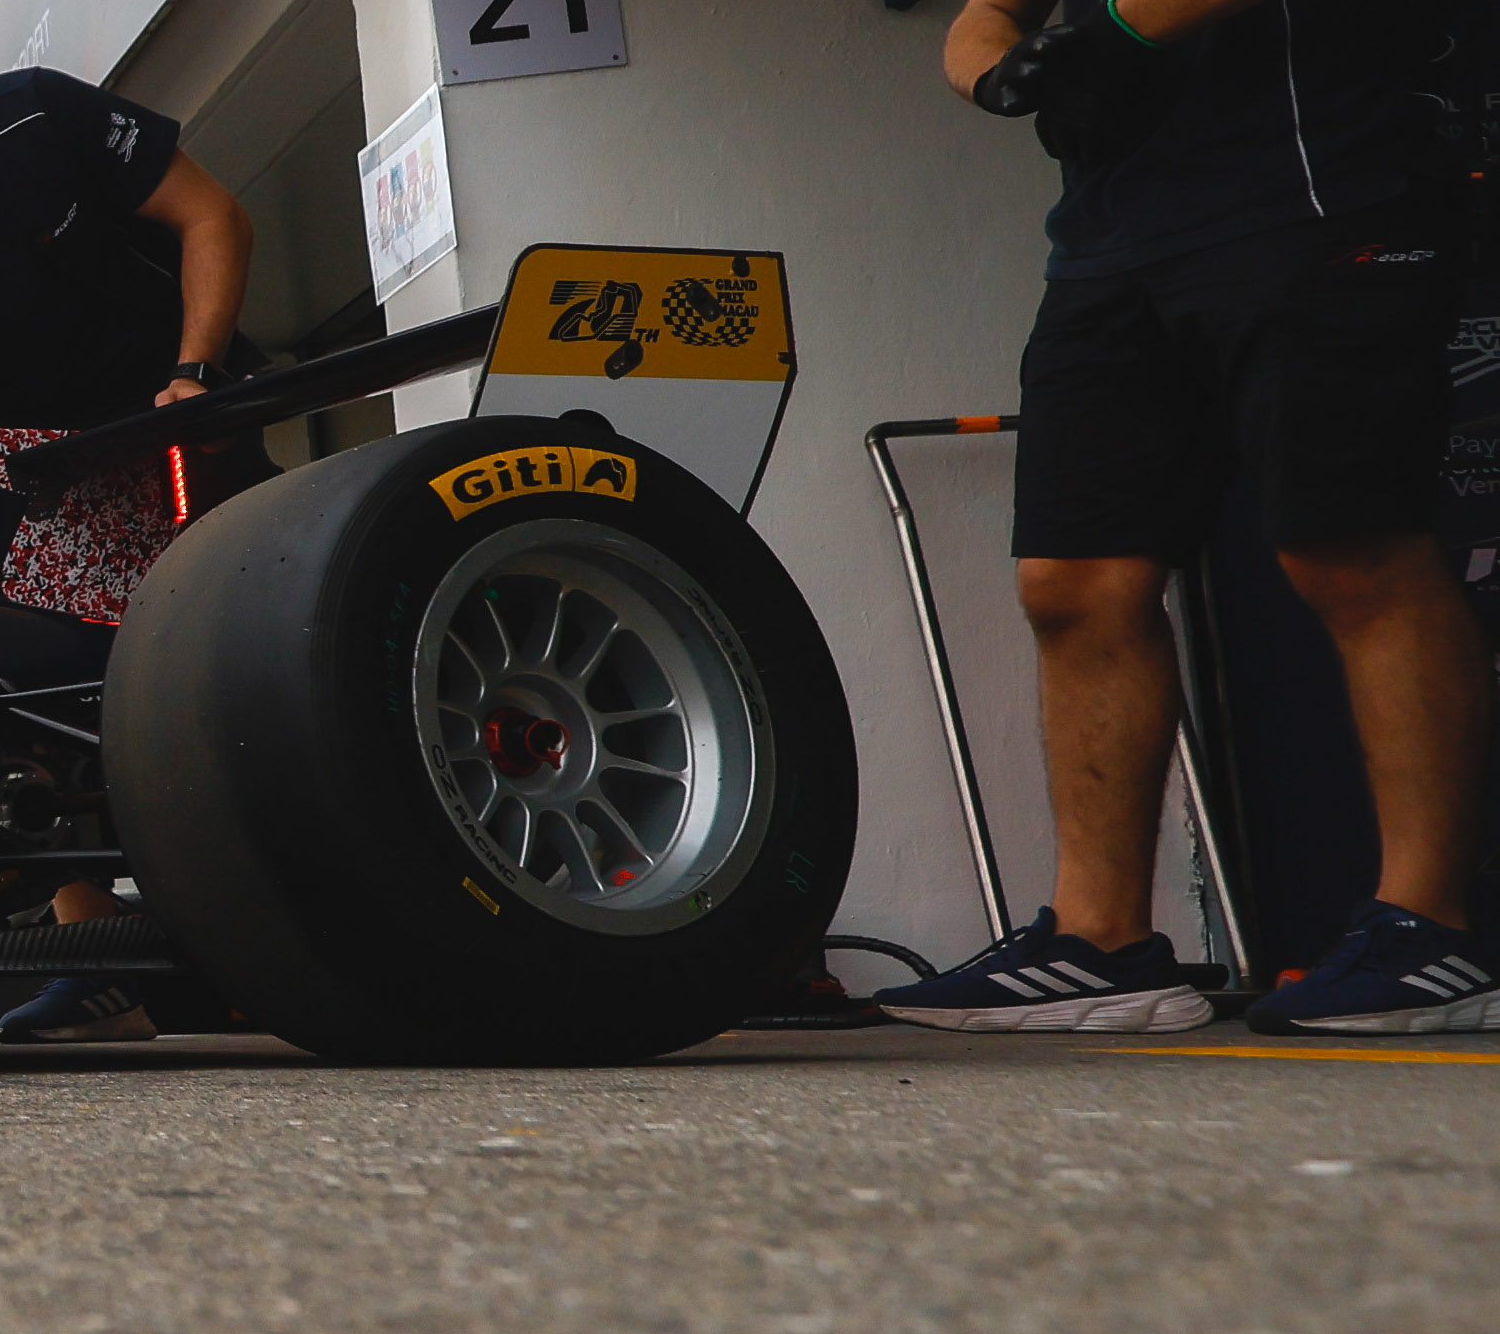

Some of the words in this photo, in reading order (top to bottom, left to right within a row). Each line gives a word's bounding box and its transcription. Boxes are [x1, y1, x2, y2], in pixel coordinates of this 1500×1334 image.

[715, 278, 758, 292] GRAND
[717, 292, 745, 304] PRIX
[451, 452, 562, 505] Giti
